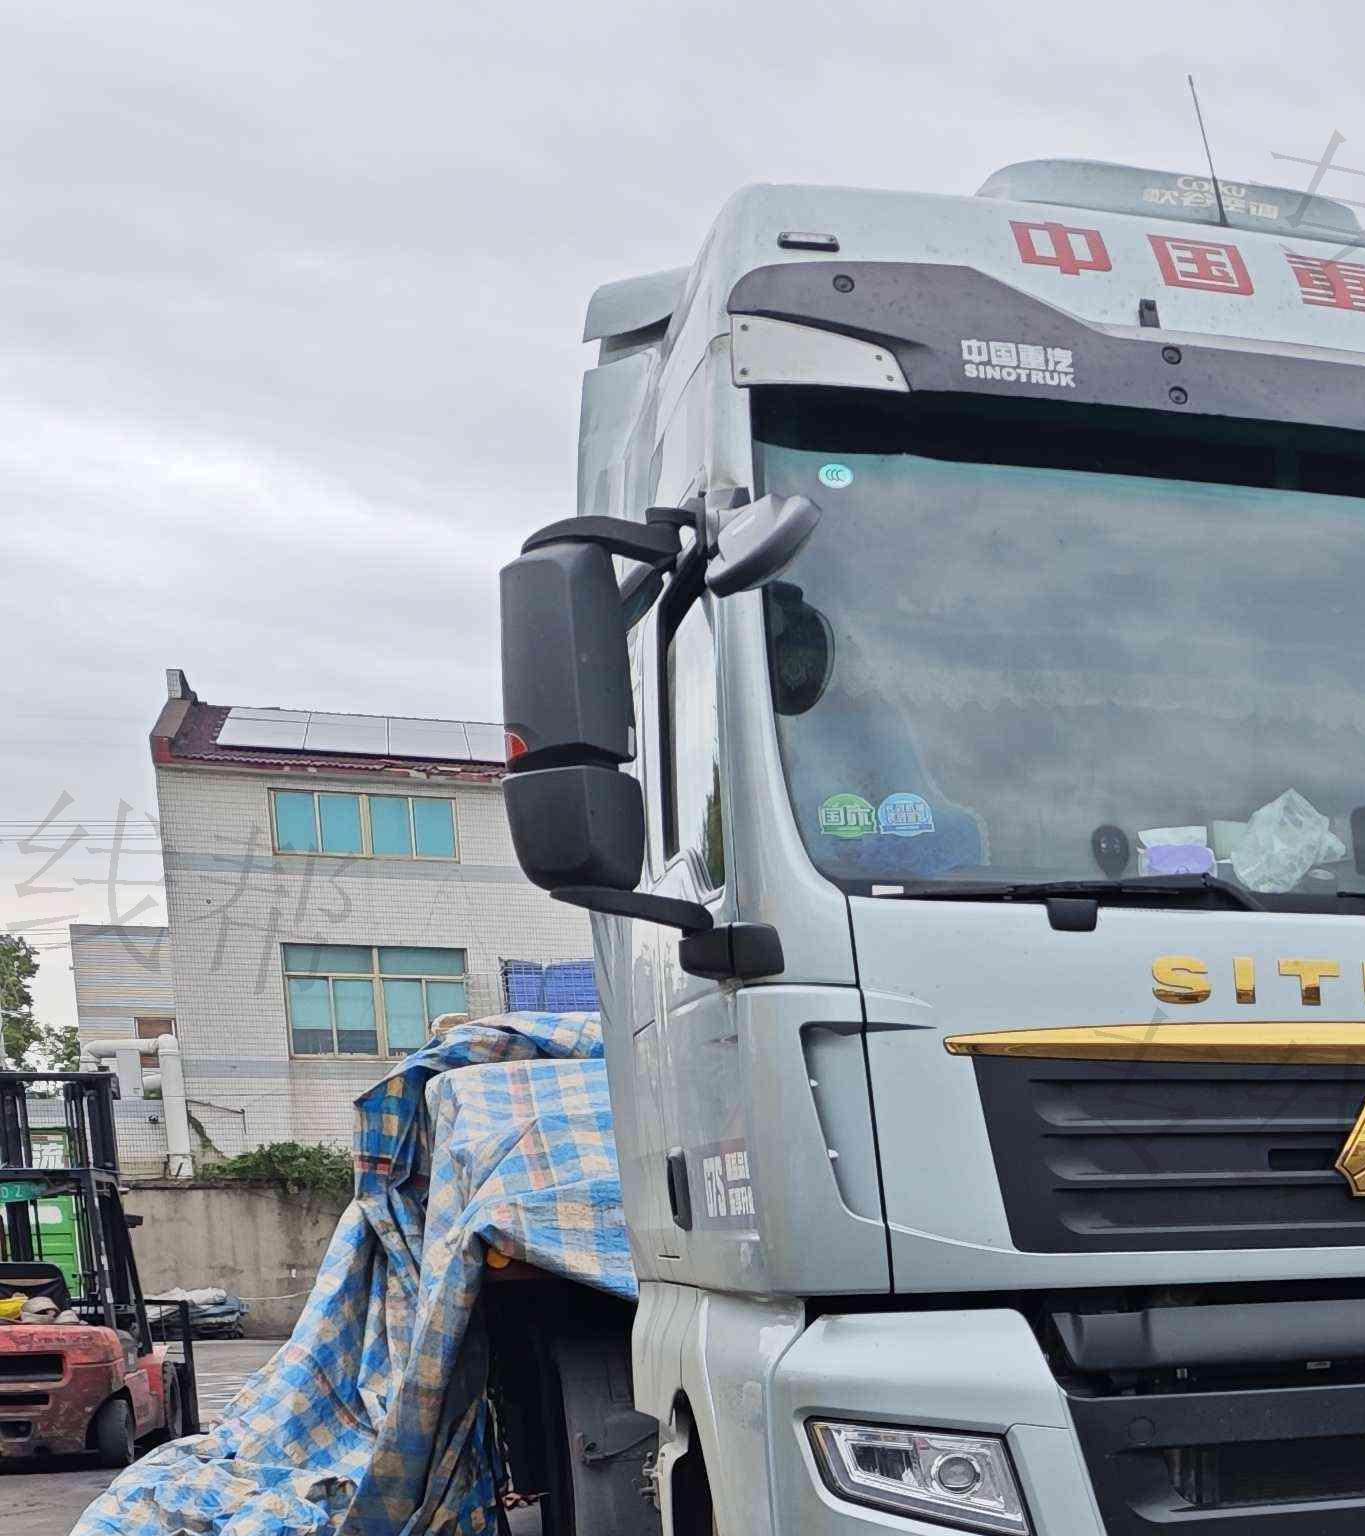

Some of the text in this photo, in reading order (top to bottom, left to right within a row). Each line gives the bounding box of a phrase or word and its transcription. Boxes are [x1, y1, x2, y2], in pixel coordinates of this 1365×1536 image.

[960, 339, 1075, 374] 中国重汽
[963, 362, 1076, 388] SINOTRUK
